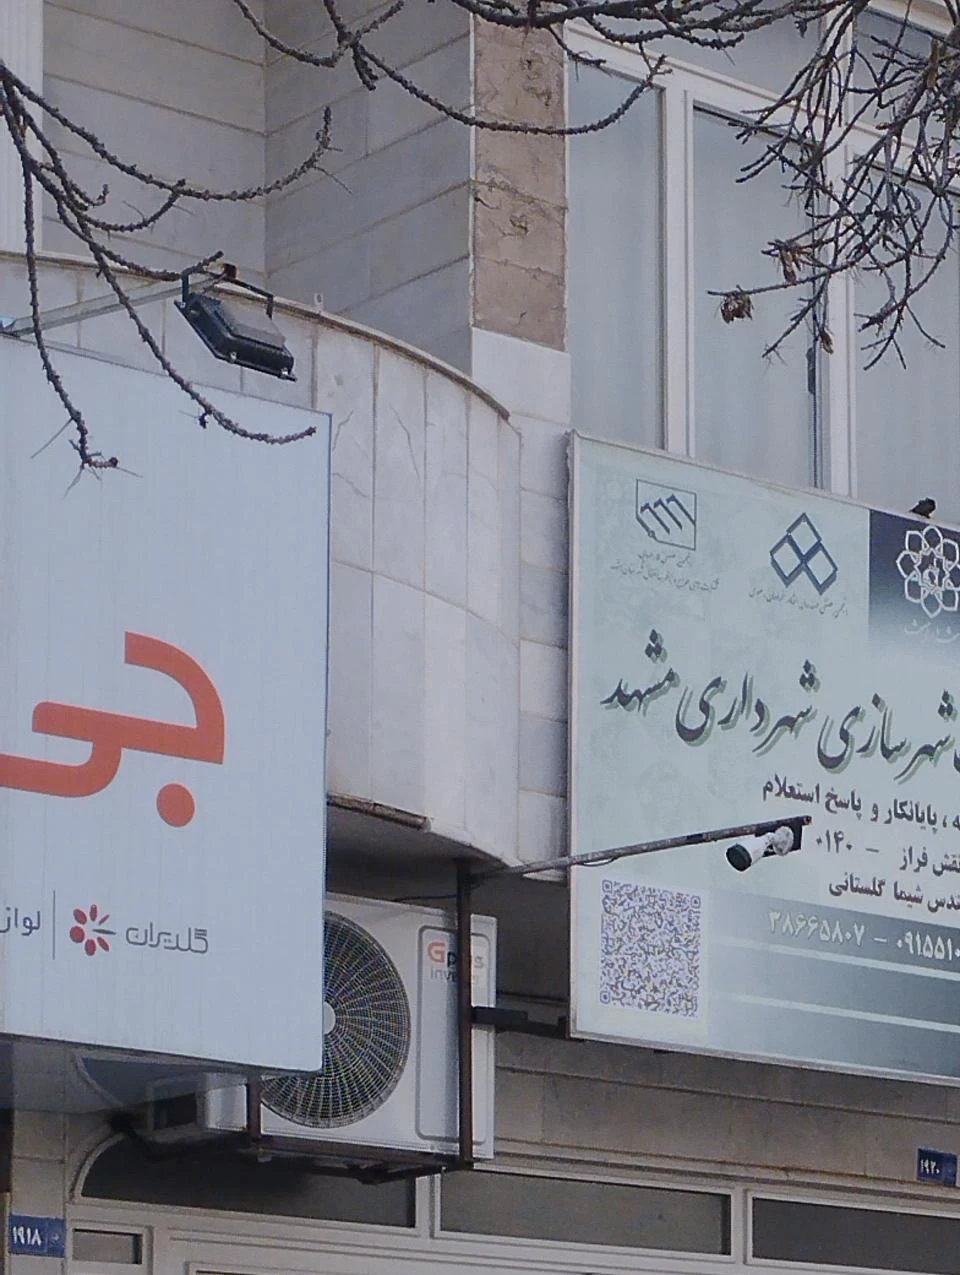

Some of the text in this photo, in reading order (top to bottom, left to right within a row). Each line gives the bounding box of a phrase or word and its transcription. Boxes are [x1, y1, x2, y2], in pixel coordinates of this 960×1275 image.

[600, 629, 679, 714] مشهد
[676, 659, 816, 754] شهرداری
[763, 774, 820, 803] استعلام
[825, 788, 862, 820] پاسخ
[870, 802, 879, 822] و
[884, 799, 938, 834] پایانکار
[900, 846, 928, 872] فراز
[829, 872, 886, 897] گلستانی
[893, 881, 923, 908] شیما
[13, 1226, 42, 1246] ۱۹۱۸
